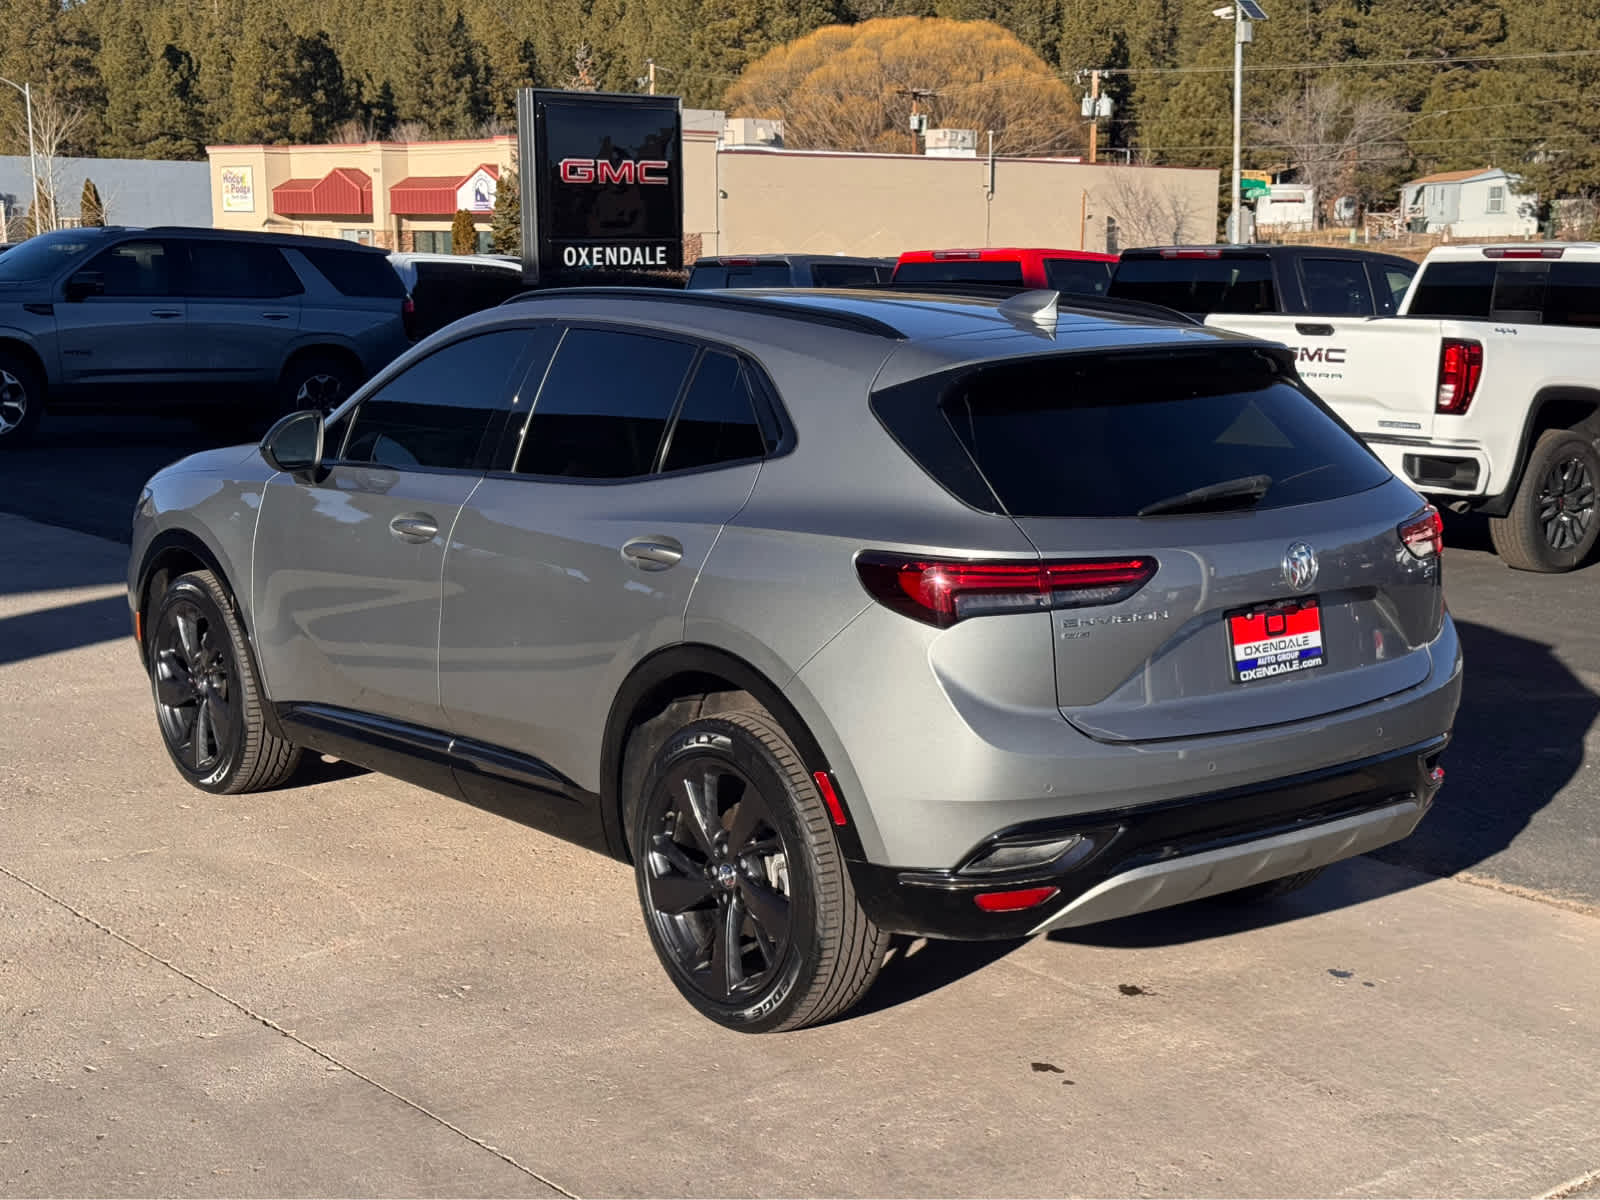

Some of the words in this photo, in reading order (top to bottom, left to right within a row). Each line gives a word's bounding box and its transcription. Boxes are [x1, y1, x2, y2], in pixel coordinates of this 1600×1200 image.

[558, 158, 668, 184] GMC
[563, 246, 667, 266] OXENDALE
[1244, 635, 1310, 657] OXENDALE
[1257, 656, 1277, 666] AUTO
[1276, 650, 1301, 662] GROUP
[1240, 658, 1322, 681] OXENDALE.com
